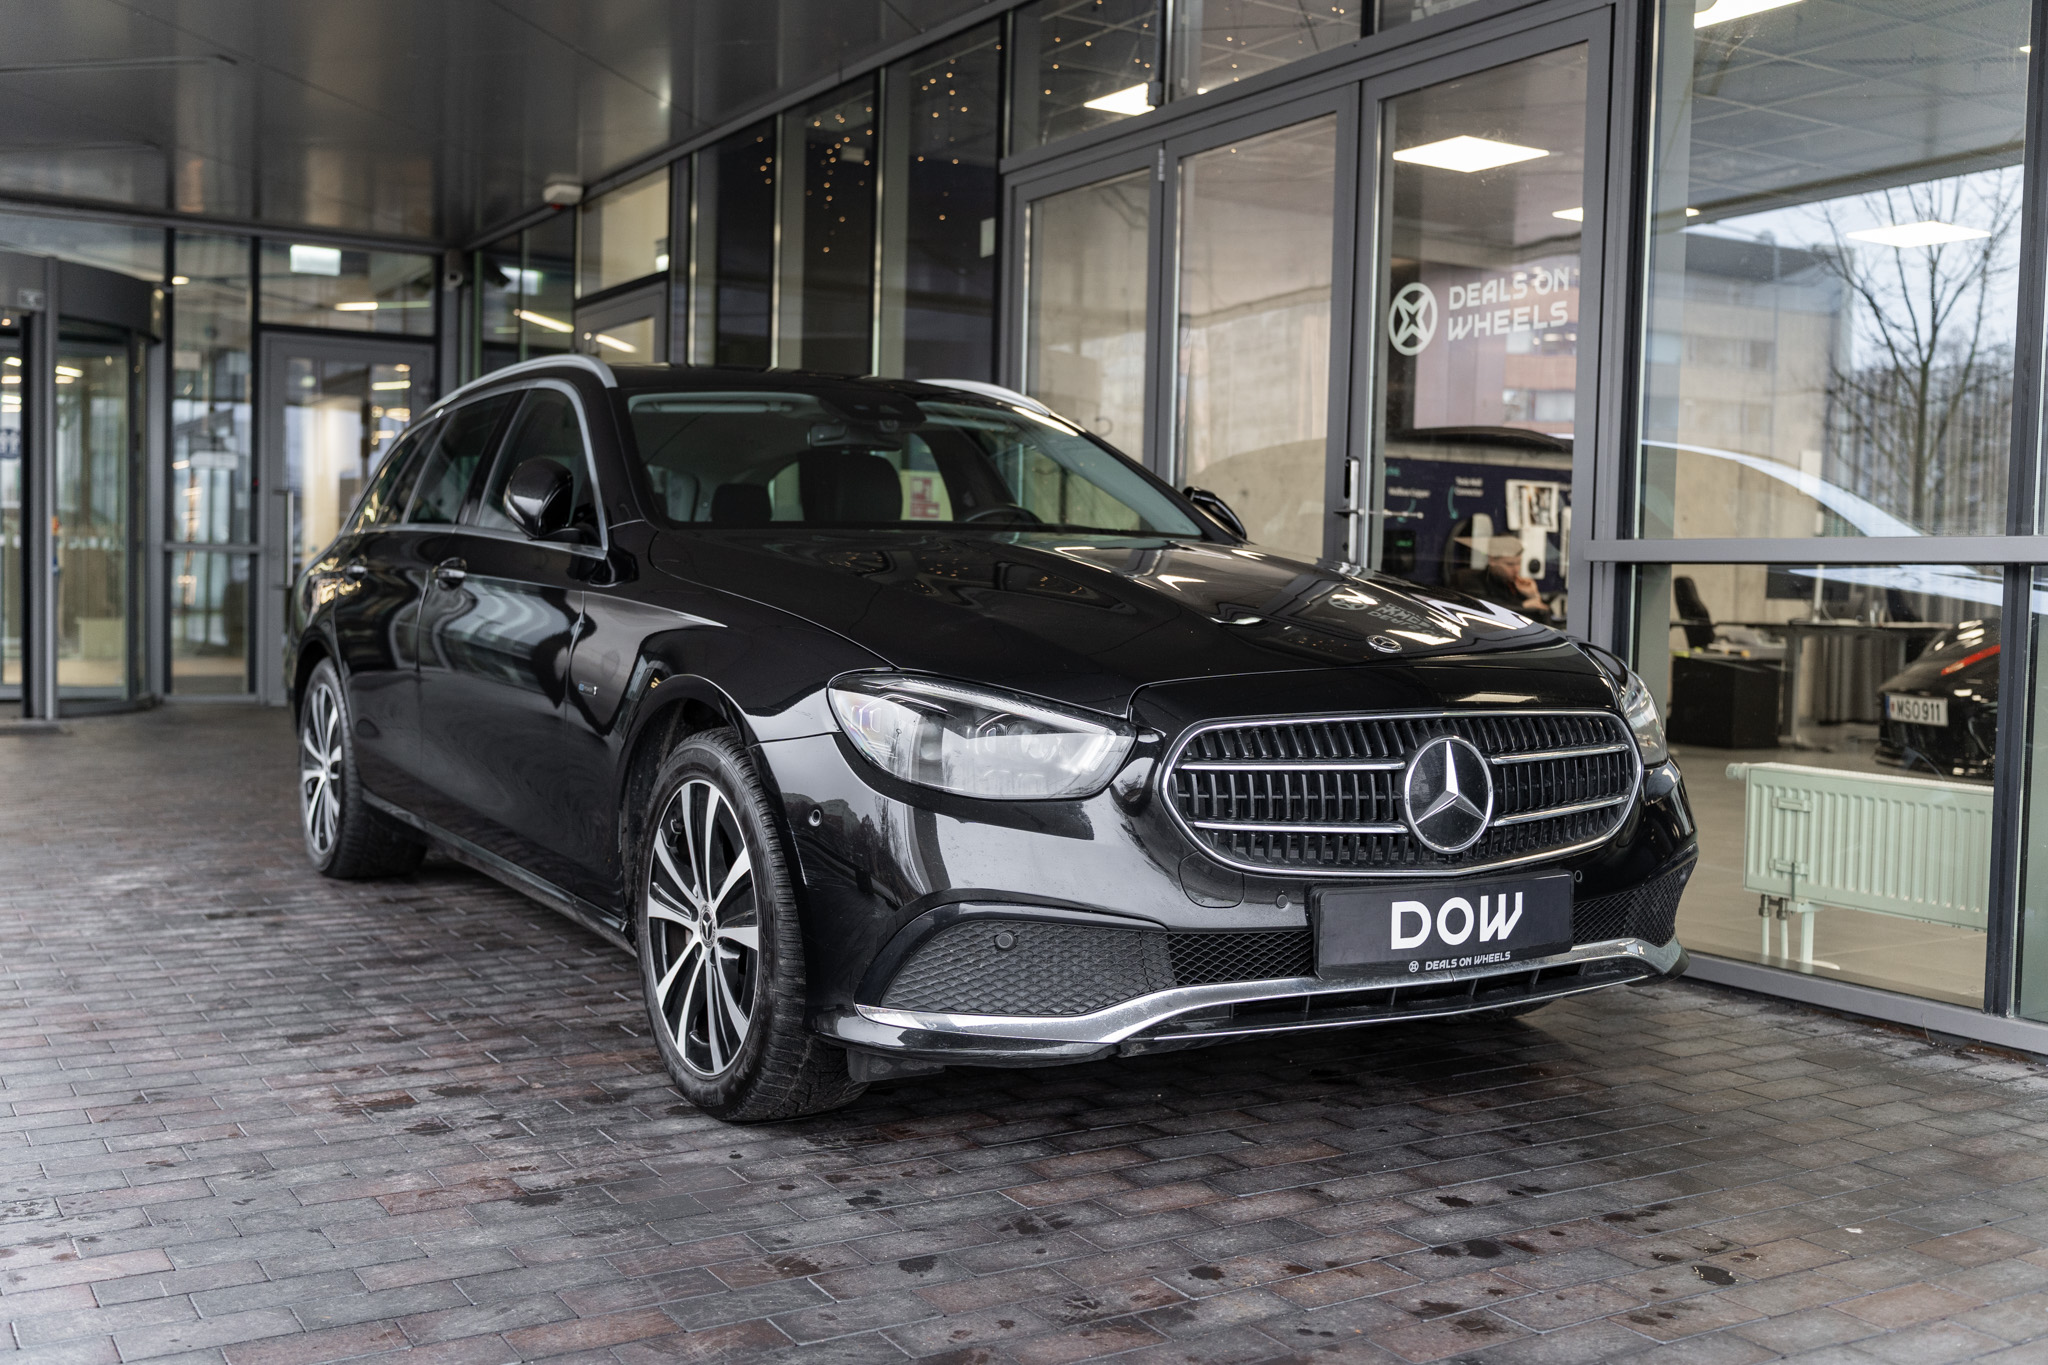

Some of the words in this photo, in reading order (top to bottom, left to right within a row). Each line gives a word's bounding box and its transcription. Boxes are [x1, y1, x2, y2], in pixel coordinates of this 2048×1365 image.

[1449, 273, 1528, 310] DEALS
[1534, 267, 1570, 296] ON
[1448, 301, 1569, 341] WHEELS
[1391, 892, 1523, 950] DOW
[1425, 958, 1457, 971] DEALS
[1459, 957, 1472, 967] ON
[1473, 951, 1511, 965] WHEELS
